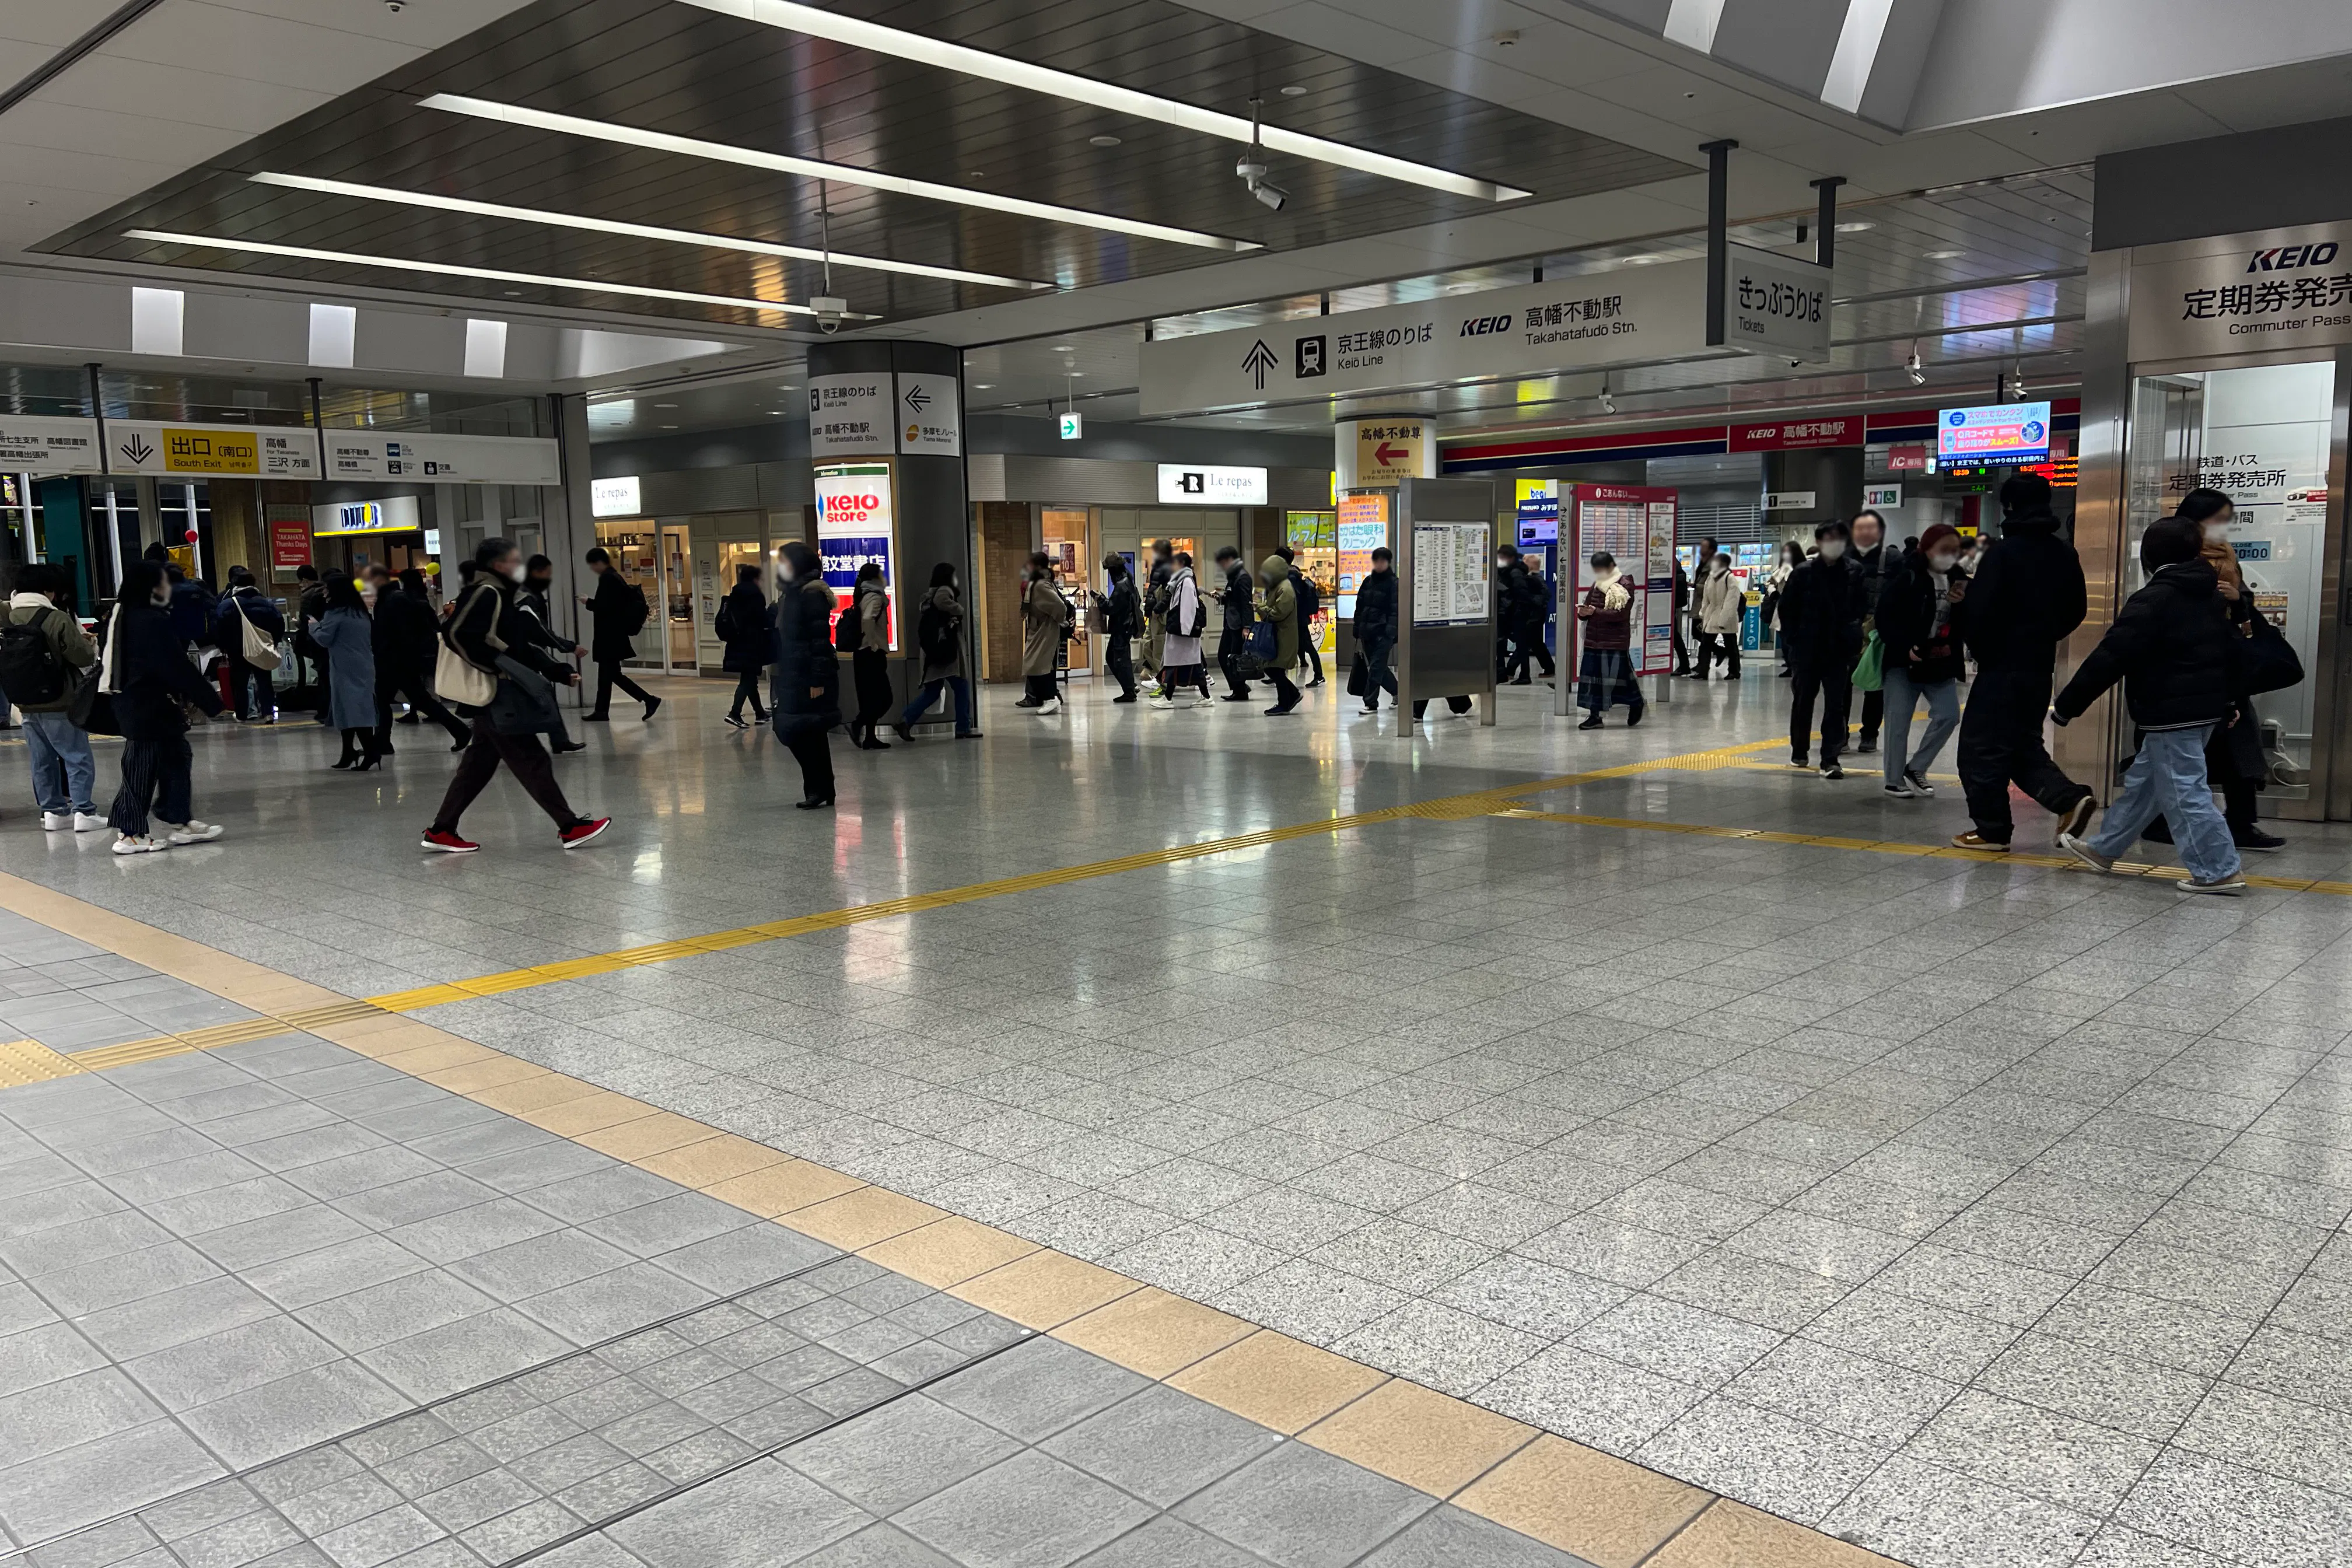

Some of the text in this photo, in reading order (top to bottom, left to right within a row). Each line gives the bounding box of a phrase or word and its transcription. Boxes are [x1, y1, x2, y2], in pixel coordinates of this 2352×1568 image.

[2246, 242, 2339, 274] KEIO
[1739, 275, 1823, 323] きっぷうりば
[1525, 295, 1622, 329] 高幡不動駅
[1460, 314, 1512, 337] KEIO
[1612, 321, 1638, 335] Stn.
[1738, 316, 1765, 334] Tickets
[2229, 314, 2351, 335] Commuter Pass
[1338, 322, 1434, 354] 京王線のりば
[1363, 354, 1383, 366] Line
[823, 386, 877, 400] 京王線のりば
[825, 422, 870, 435] 高幡不動駅
[1361, 426, 1421, 440] 高幡不動尊
[1746, 428, 1776, 439] KEIO
[1783, 422, 1845, 439] 高幡不動駅
[172, 436, 212, 456] 出口
[265, 438, 288, 449] 高幡
[173, 459, 222, 468] South Exit
[268, 457, 311, 468] 三沢 方面
[1892, 456, 1905, 467] IC
[2197, 454, 2258, 468] 鉄道・バス
[1210, 473, 1252, 489] Le repas
[2169, 469, 2286, 491] 定期券発売所
[608, 488, 628, 501] repas
[827, 511, 868, 523] store
